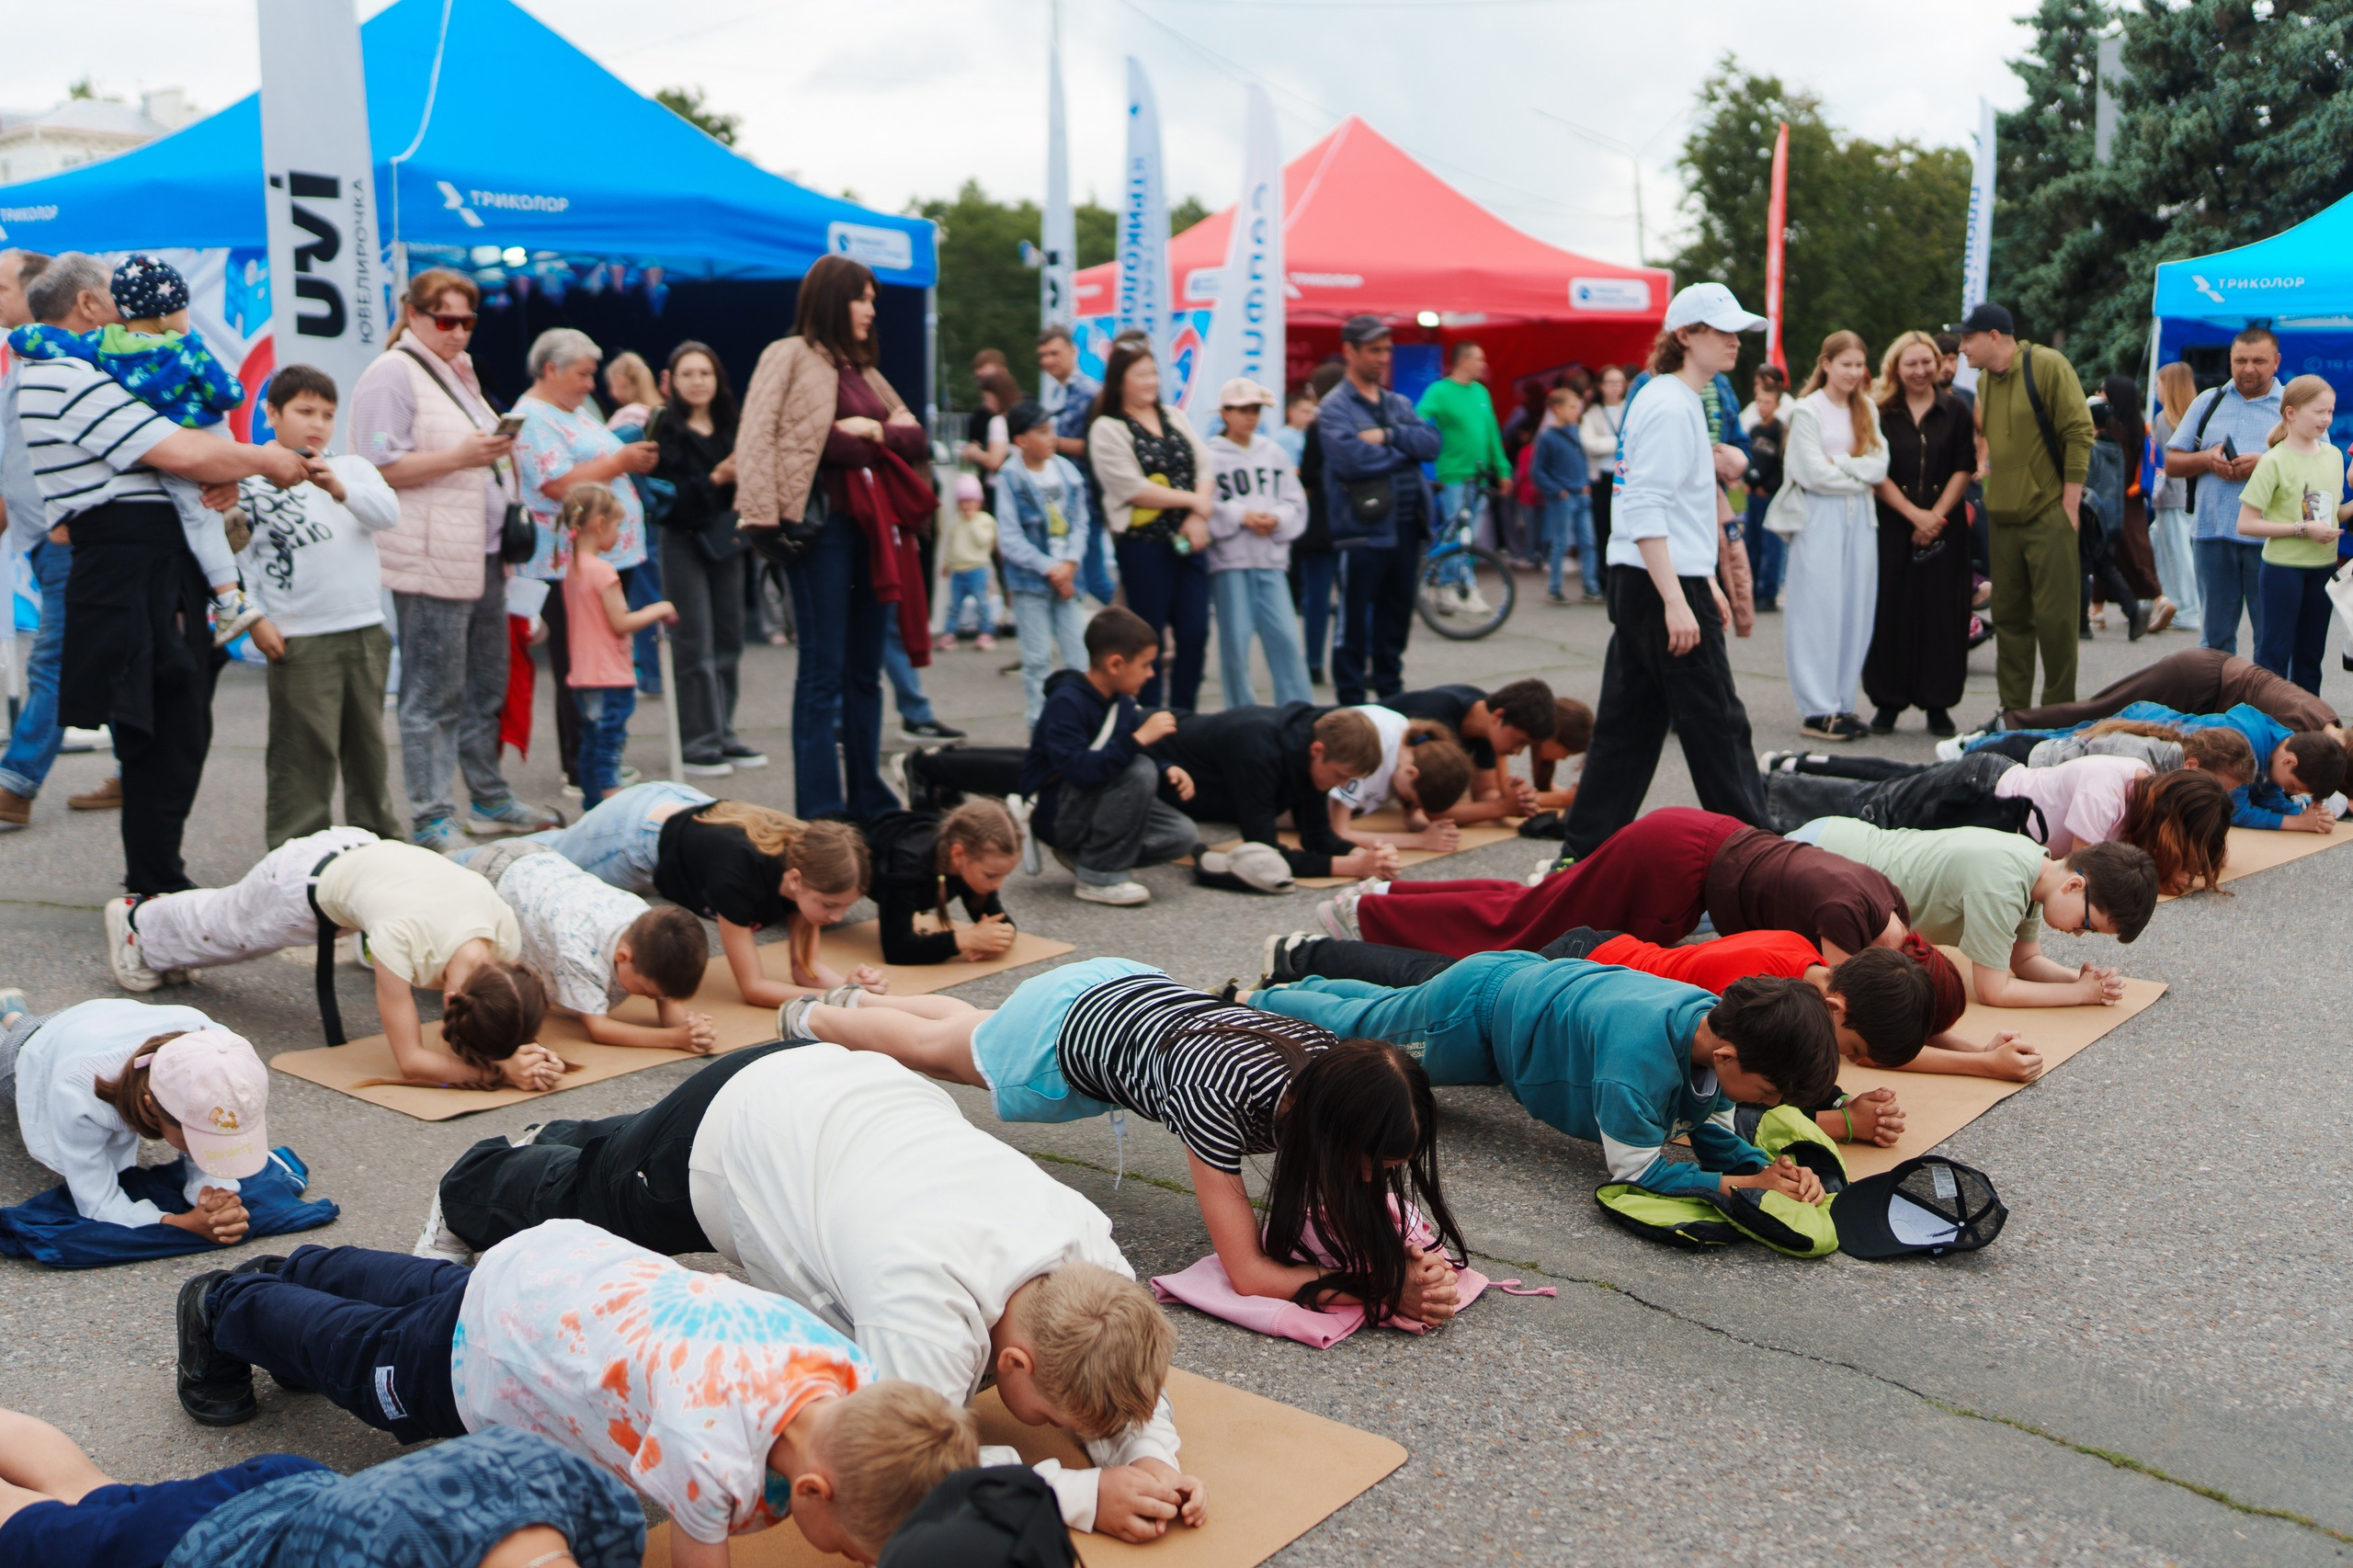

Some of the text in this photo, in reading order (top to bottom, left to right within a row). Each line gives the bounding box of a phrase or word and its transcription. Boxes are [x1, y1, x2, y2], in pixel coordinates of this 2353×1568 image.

[470, 189, 569, 212] ТРИКОЛОР
[354, 177, 373, 345] ЮВЕЛИРОЧКА
[2218, 277, 2305, 290] ТРИКОЛОР
[1216, 467, 1284, 502] SOFT
